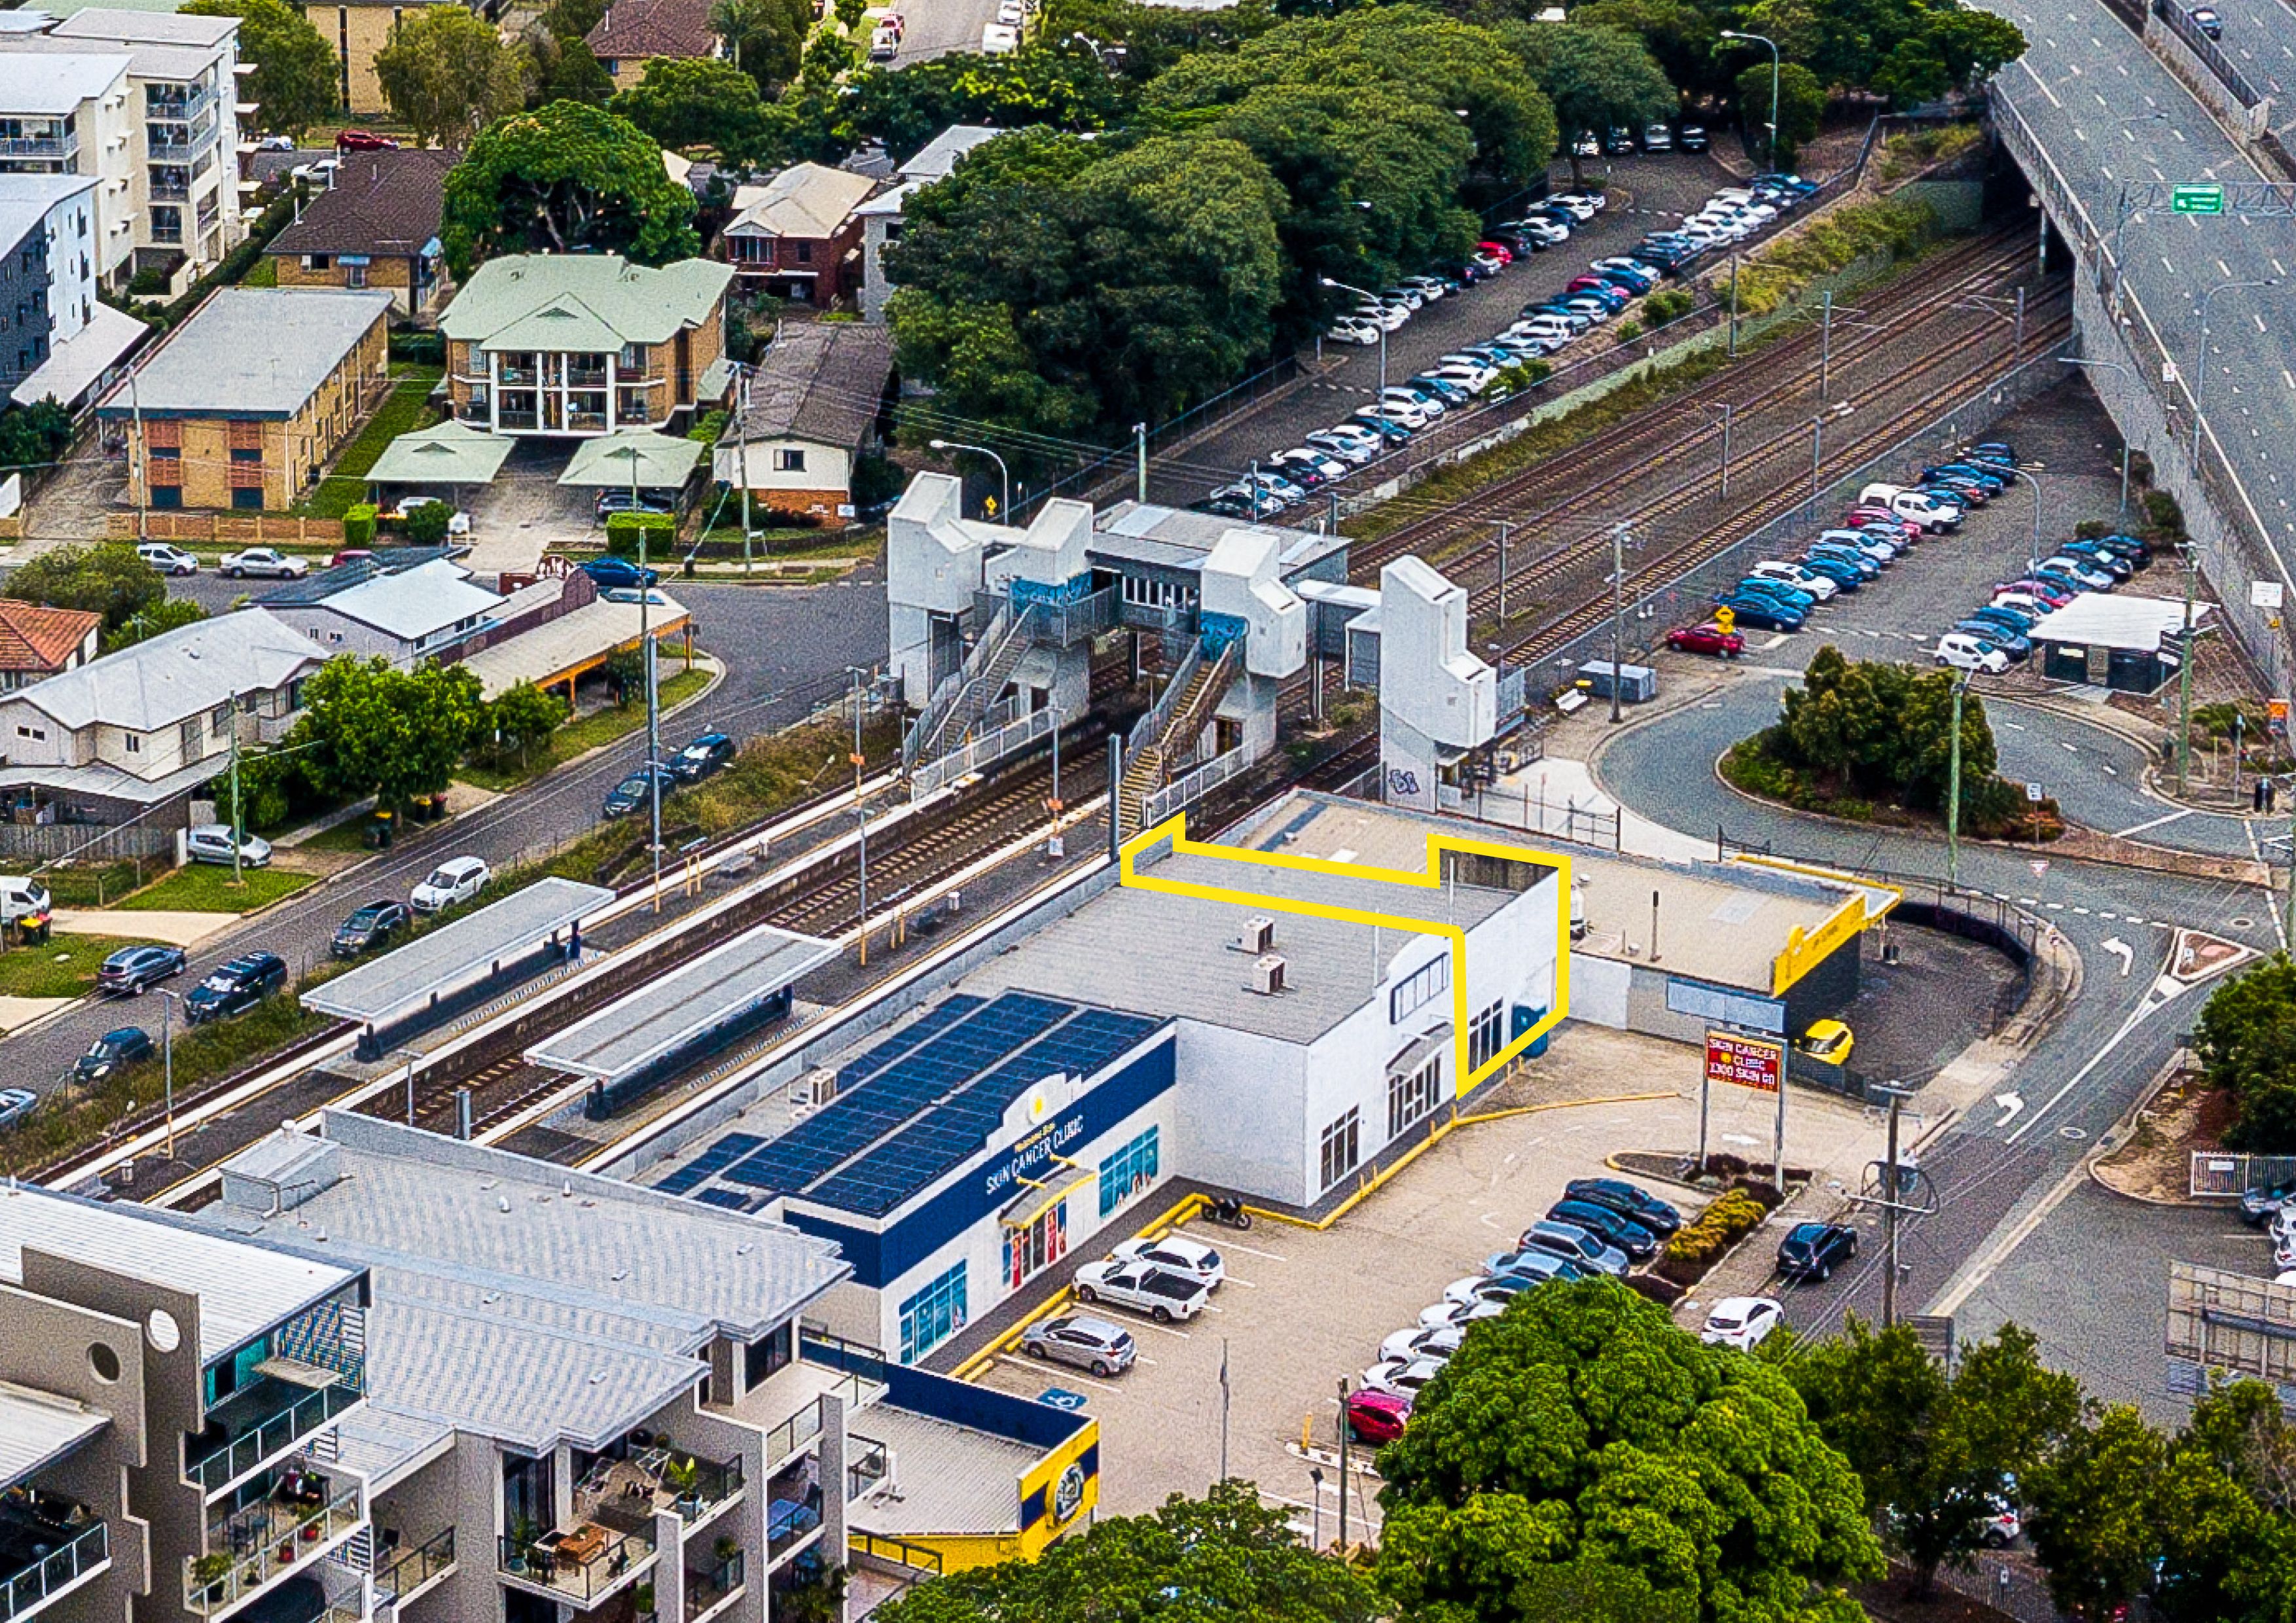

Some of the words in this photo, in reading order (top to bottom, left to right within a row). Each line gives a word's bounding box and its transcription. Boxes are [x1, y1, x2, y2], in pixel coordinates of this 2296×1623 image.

[986, 1165, 1011, 1195] SKIN
[1012, 1135, 1052, 1178] CANCER
[1054, 1115, 1084, 1149] CLINIC
